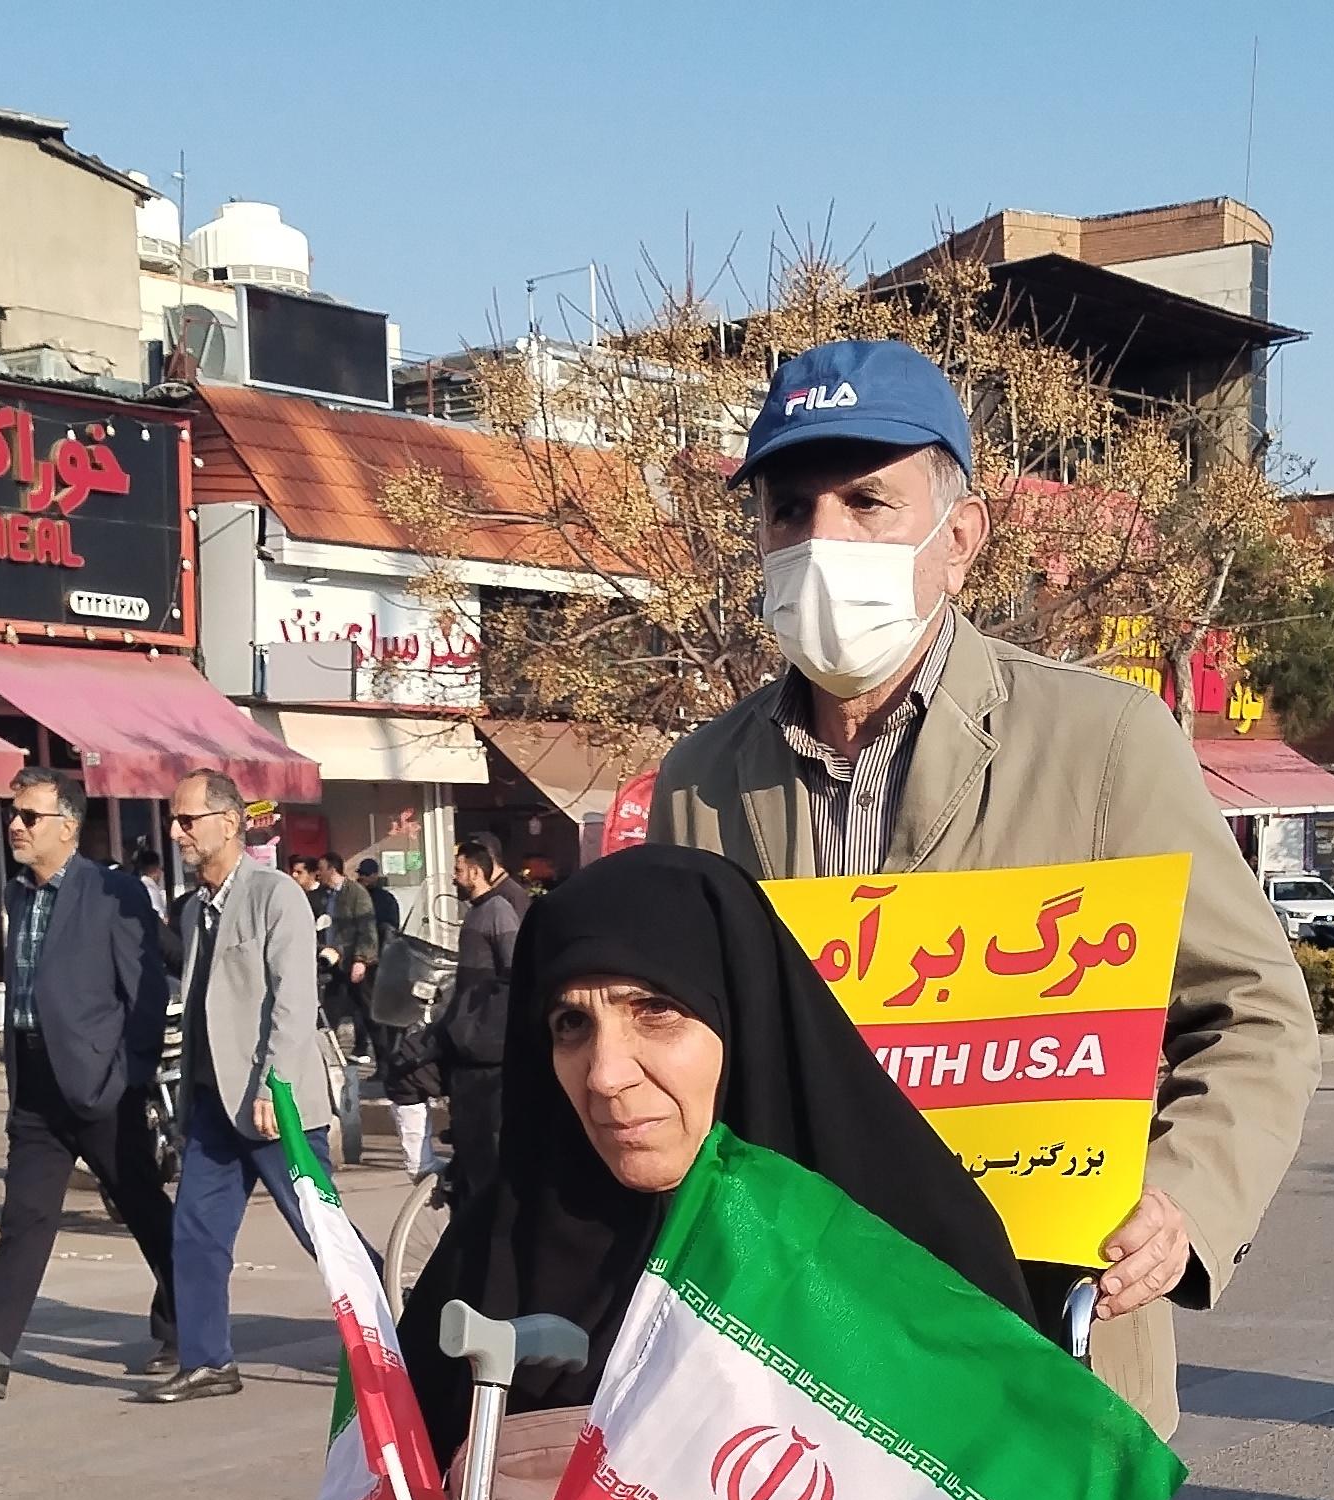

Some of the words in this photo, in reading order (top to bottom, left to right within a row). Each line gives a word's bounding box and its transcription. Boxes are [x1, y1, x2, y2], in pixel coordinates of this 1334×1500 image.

[784, 381, 858, 416] FILA
[984, 886, 1137, 999] مرگ
[883, 925, 965, 1008] بر
[981, 1034, 1106, 1081] U.S.A
[969, 1141, 1105, 1179] بزرگترین
